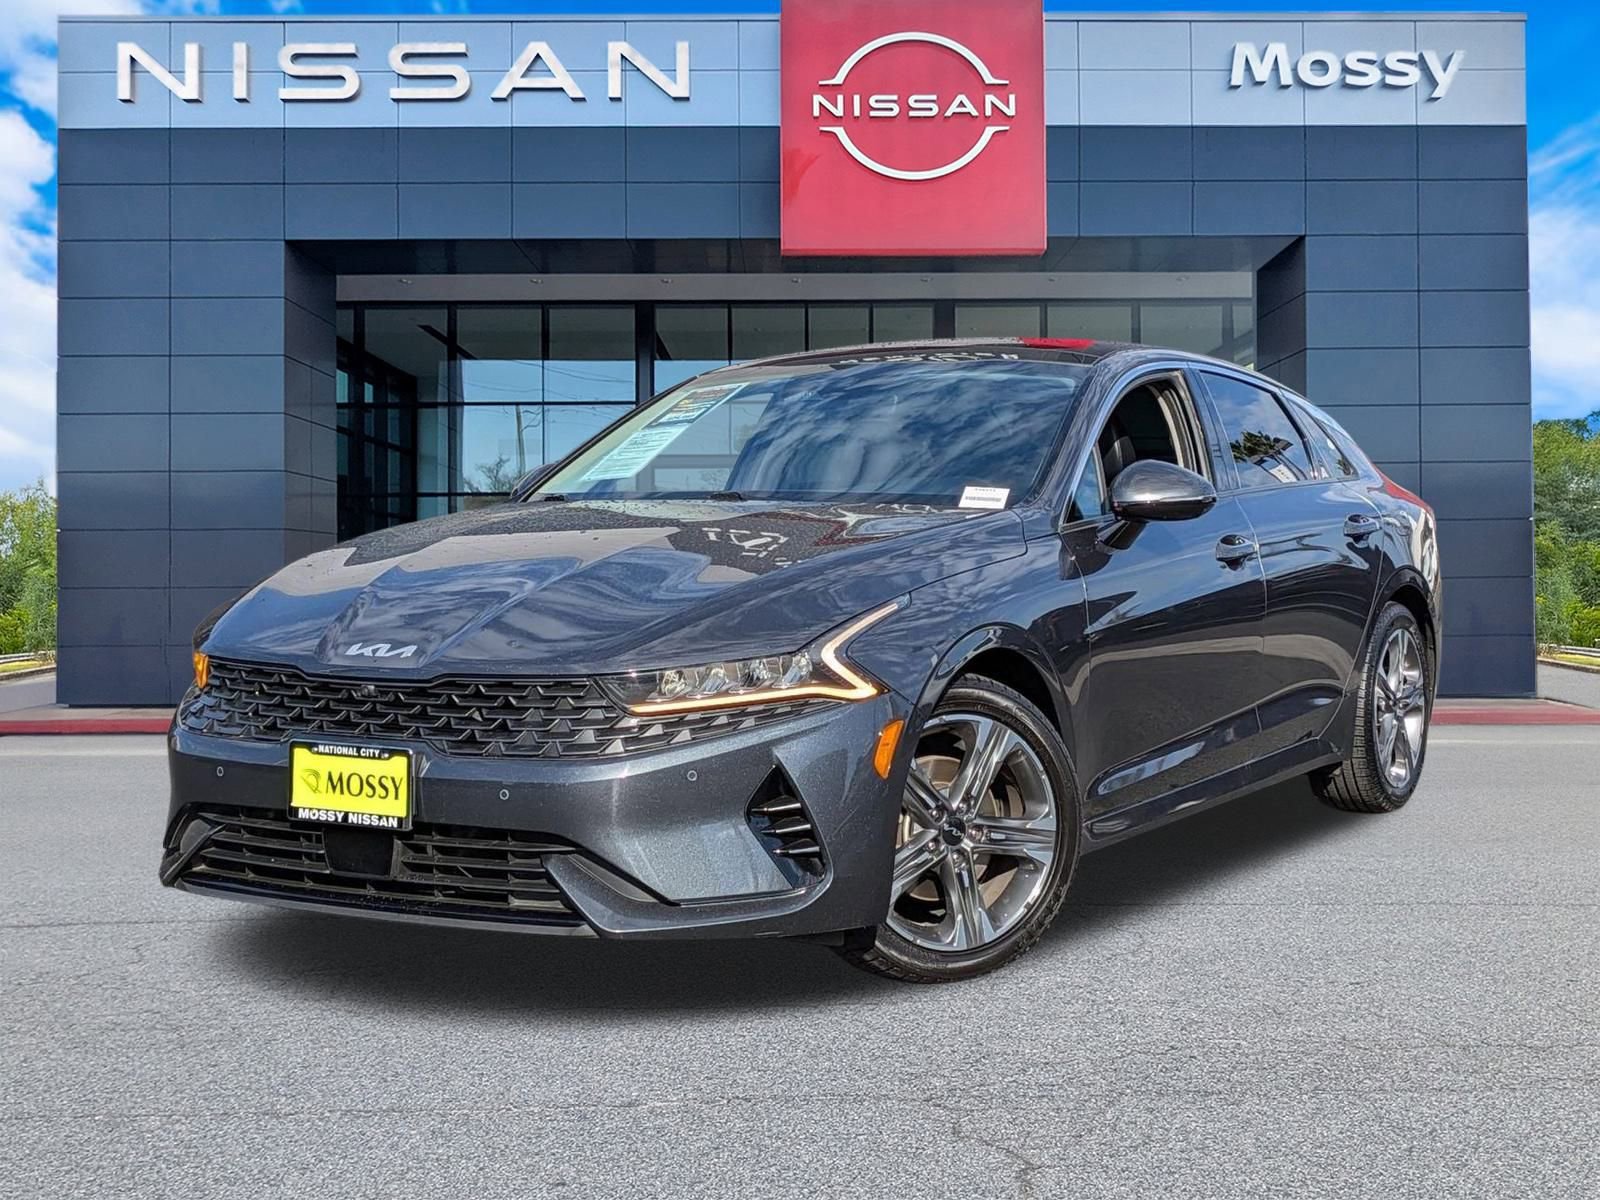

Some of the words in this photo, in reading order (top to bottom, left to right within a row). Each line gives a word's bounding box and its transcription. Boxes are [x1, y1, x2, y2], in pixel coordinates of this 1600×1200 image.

[116, 41, 691, 102] NISSAN
[1230, 41, 1466, 99] Mossy
[812, 93, 1017, 118] NISSAN
[345, 642, 418, 658] KIA
[318, 744, 359, 756] NATIONAL
[360, 747, 380, 758] CITY
[326, 770, 404, 801] MOSSY
[298, 807, 345, 823] MOSSY
[348, 812, 398, 828] NISSAN
